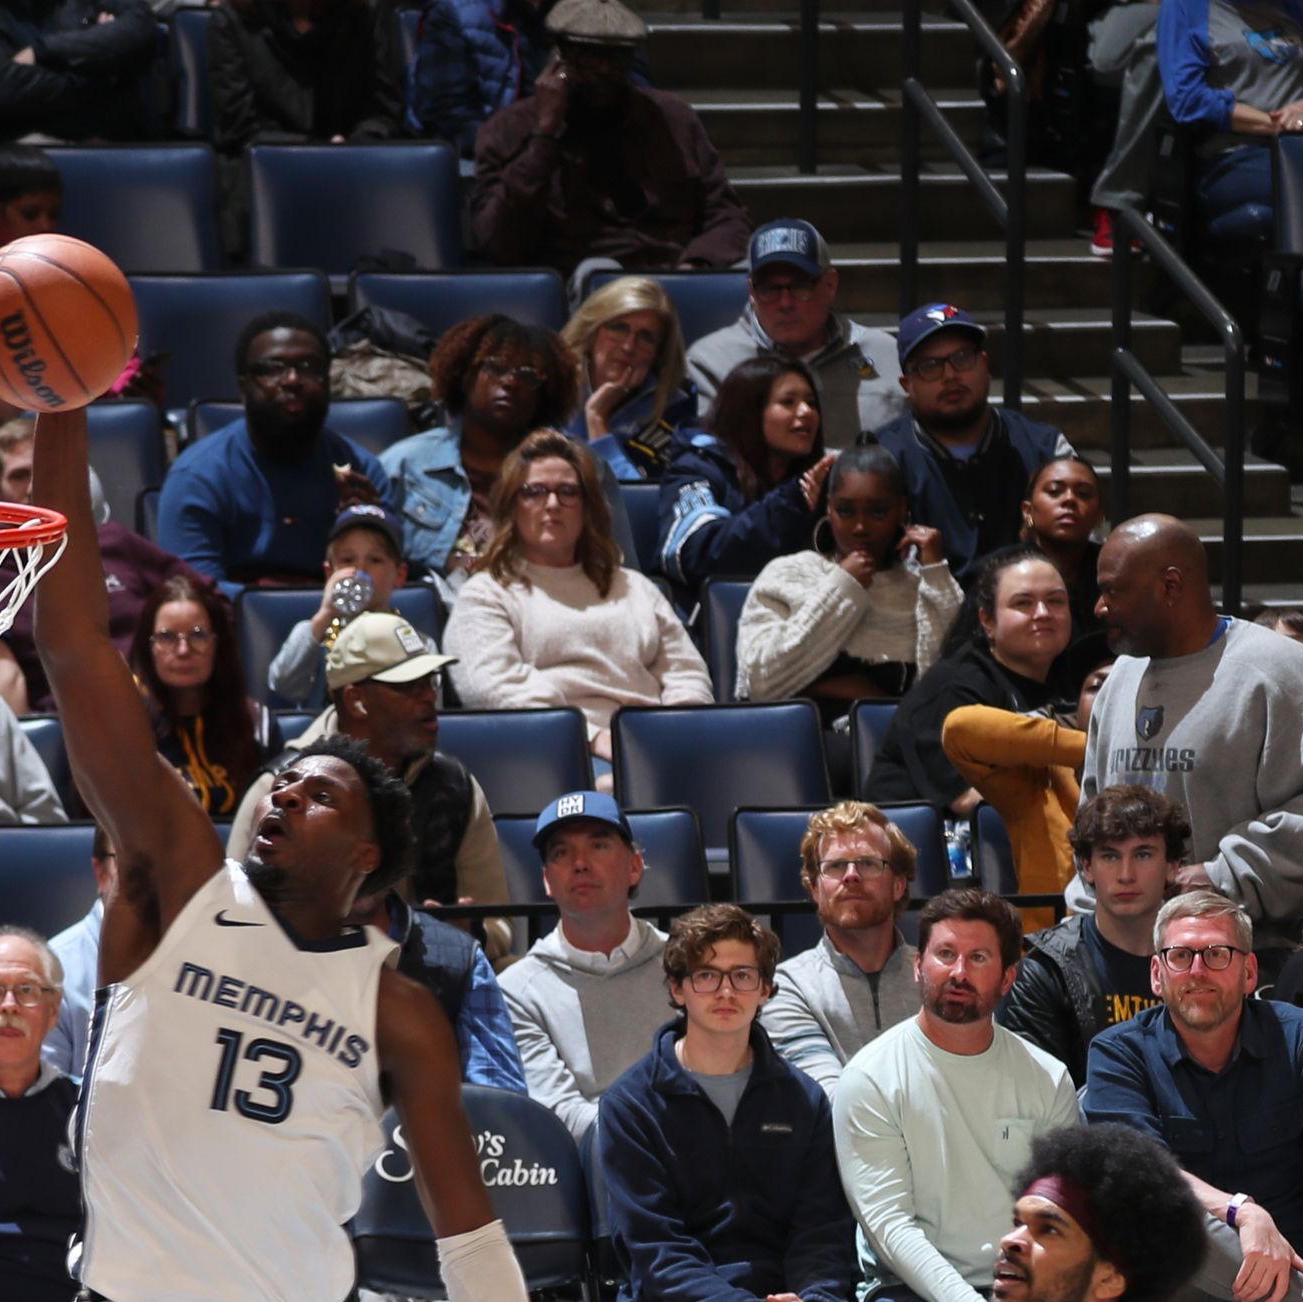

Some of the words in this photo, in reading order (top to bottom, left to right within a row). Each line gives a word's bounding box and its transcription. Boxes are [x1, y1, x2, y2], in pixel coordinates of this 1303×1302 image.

[0, 310, 65, 408] Wilson
[172, 961, 370, 1069] MEMPHIS
[210, 1027, 303, 1125] 13
[480, 1158, 559, 1187] Cabin
